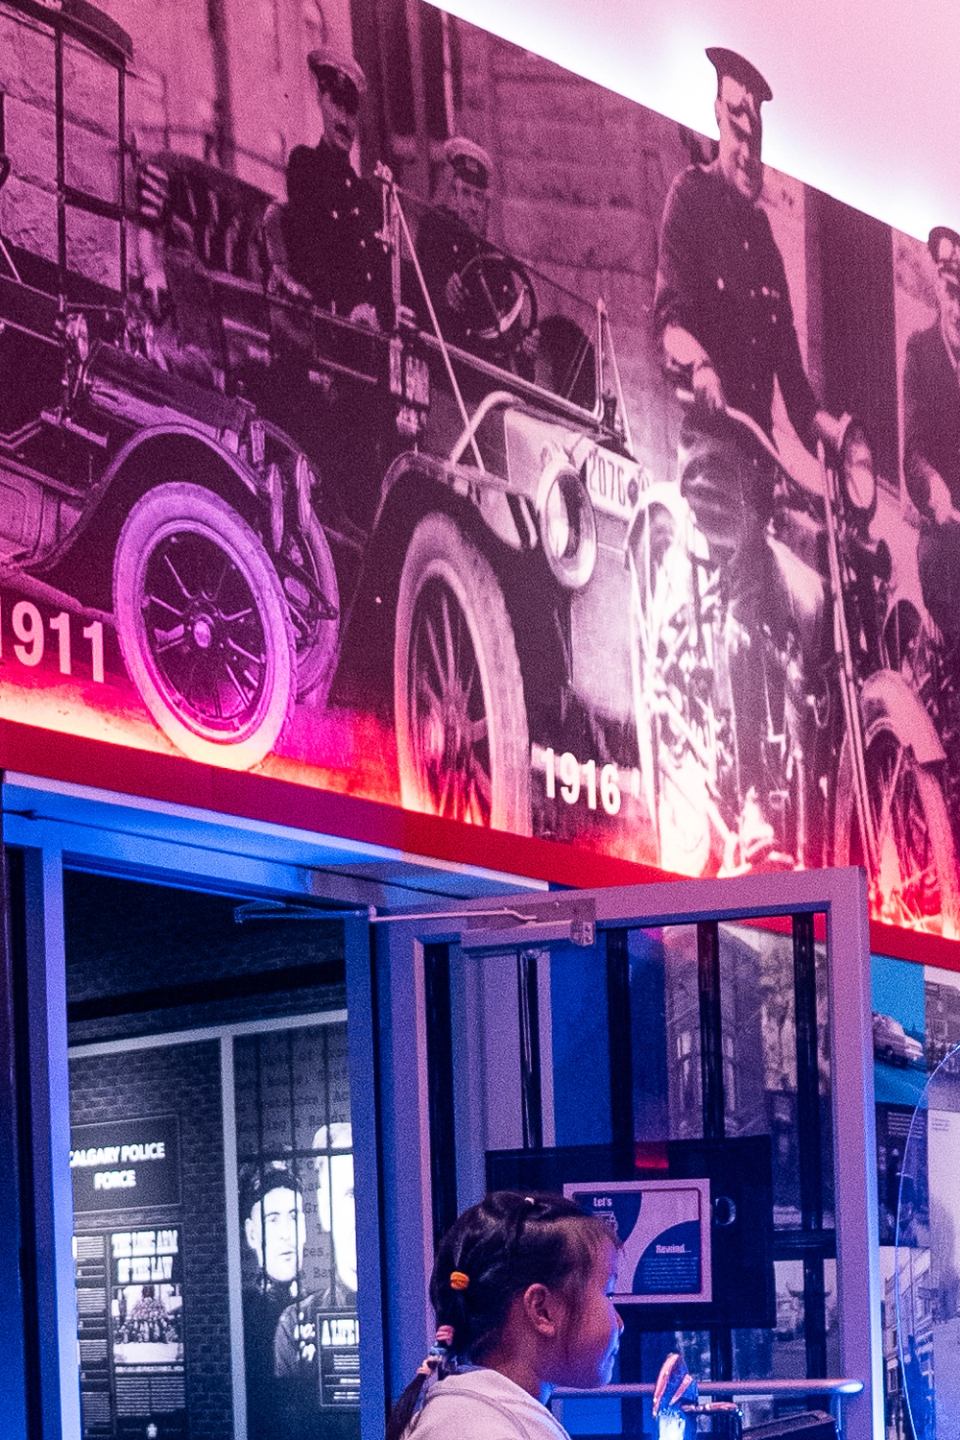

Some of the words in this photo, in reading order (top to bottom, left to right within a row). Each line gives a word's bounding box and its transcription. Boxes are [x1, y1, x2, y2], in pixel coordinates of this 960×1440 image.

[0, 598, 105, 684] 911
[540, 746, 621, 815] 1916
[121, 1142, 165, 1162] POLICE
[94, 1169, 136, 1191] FORCE
